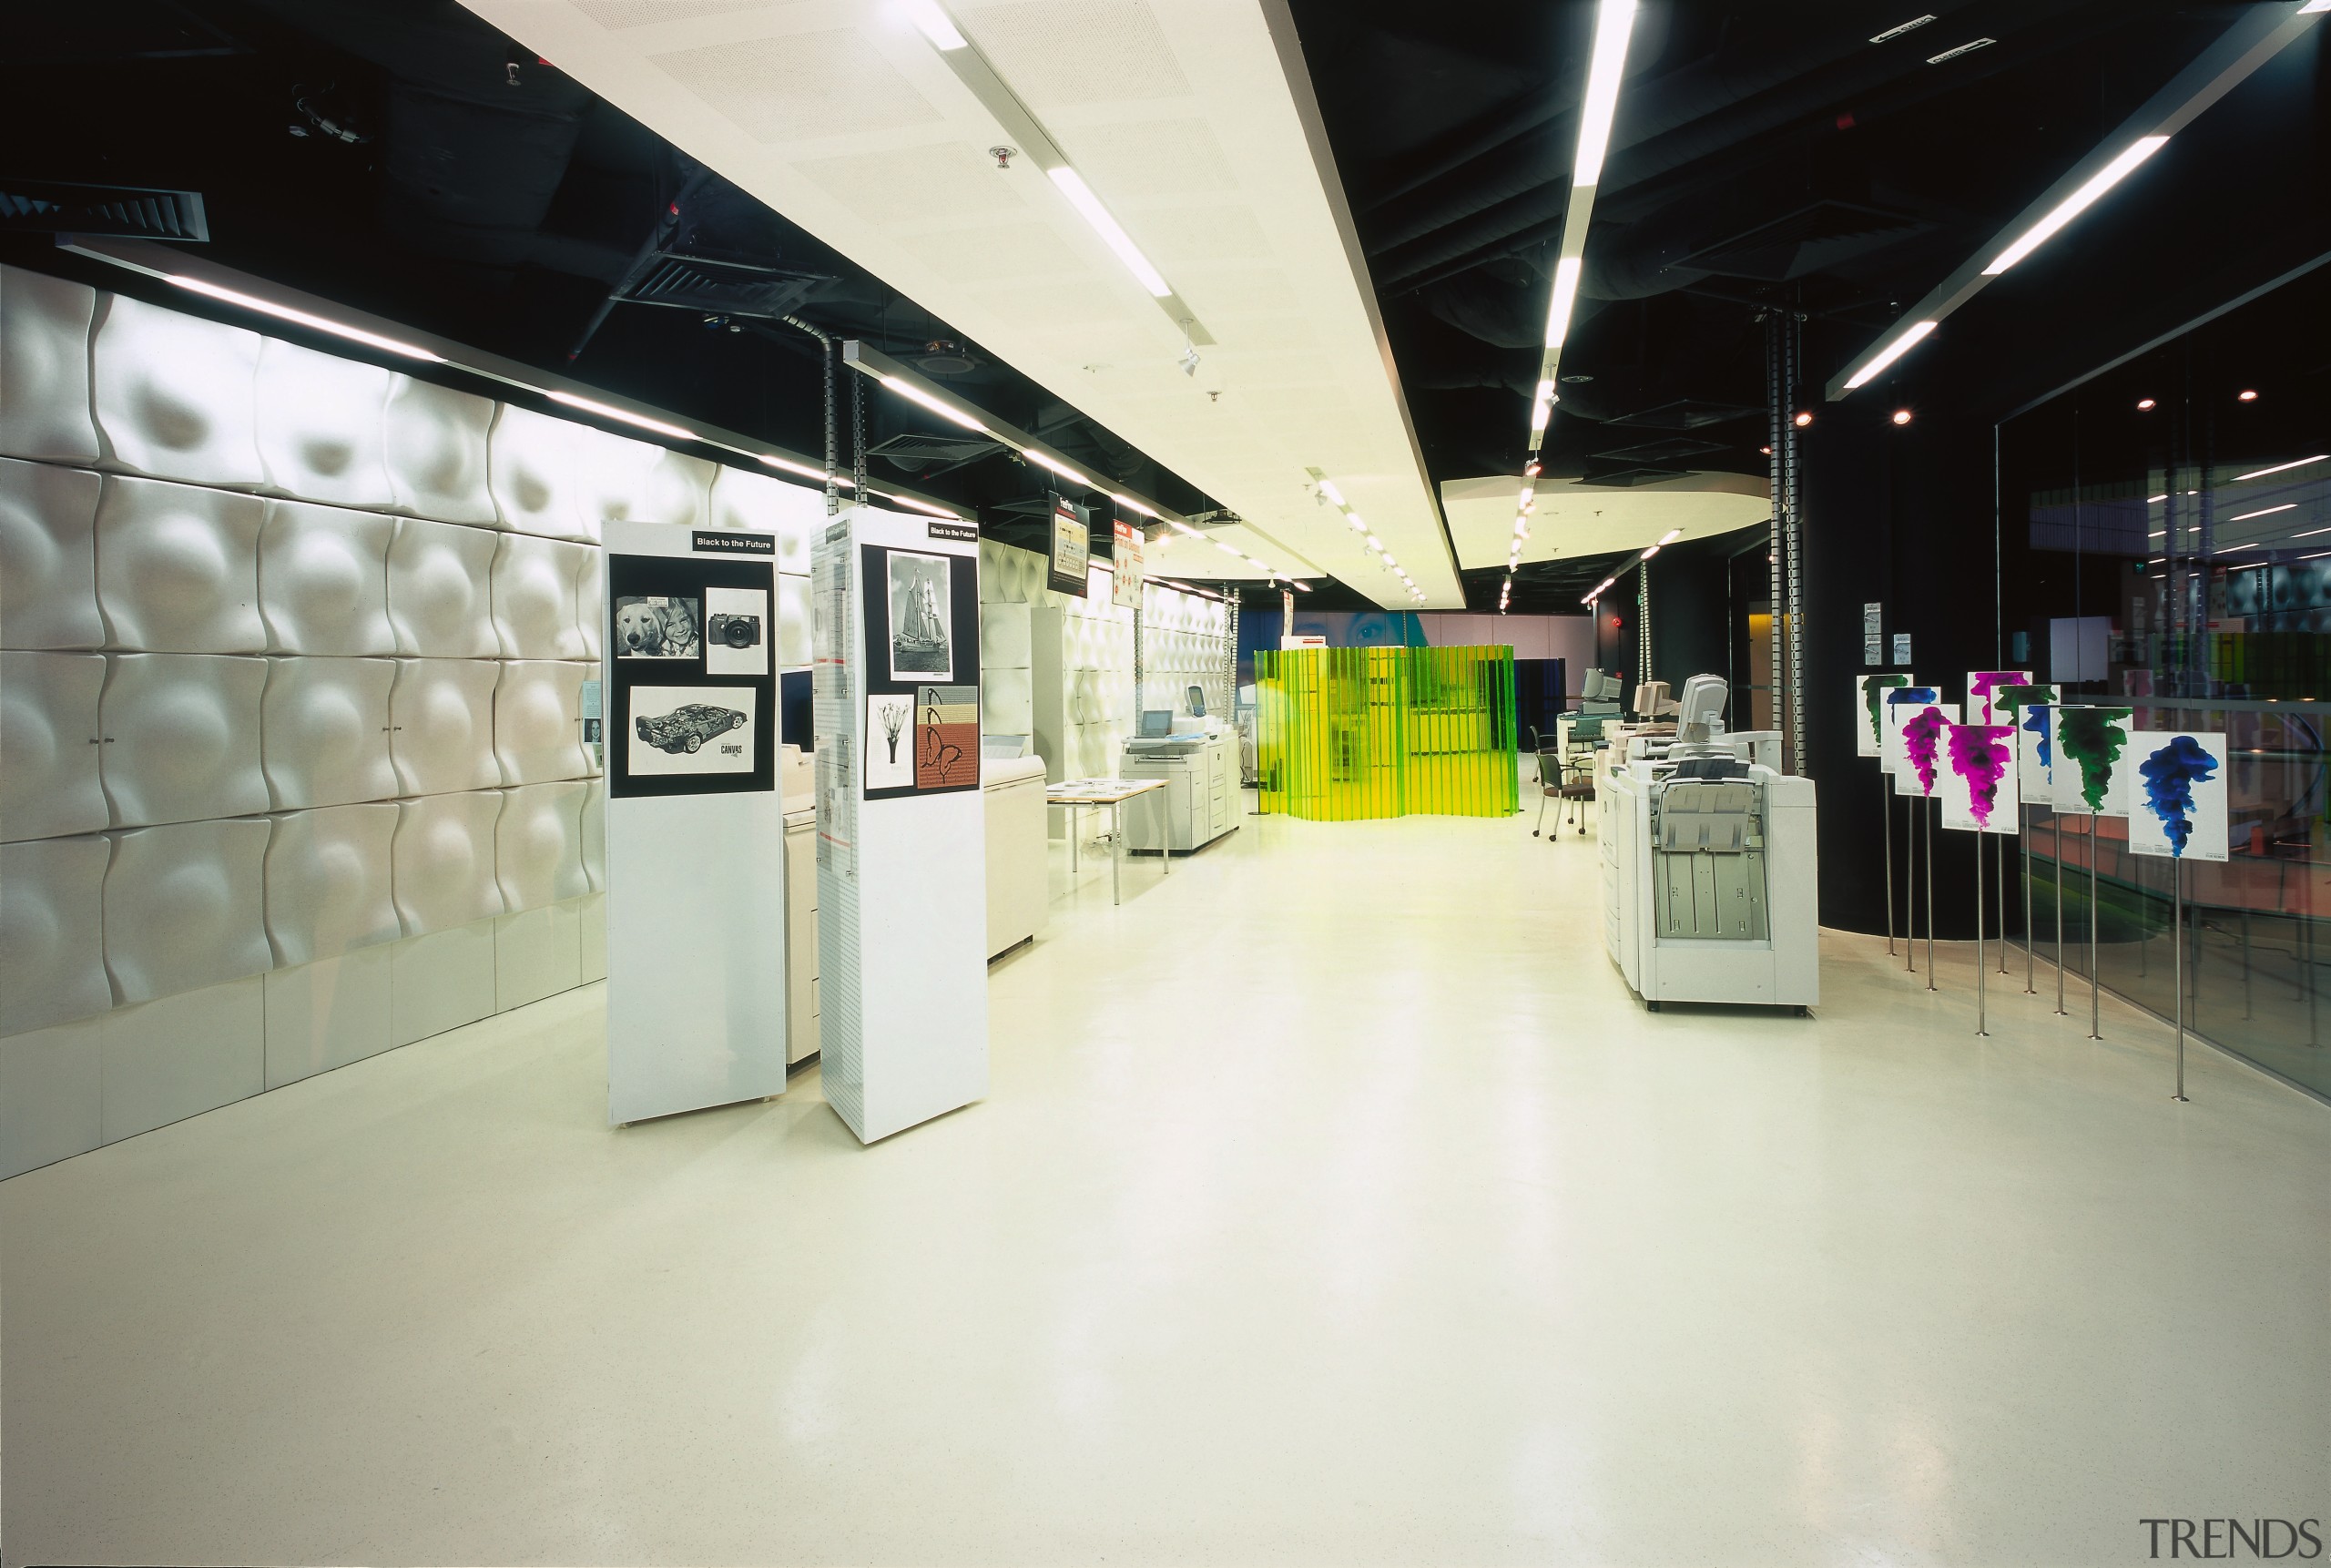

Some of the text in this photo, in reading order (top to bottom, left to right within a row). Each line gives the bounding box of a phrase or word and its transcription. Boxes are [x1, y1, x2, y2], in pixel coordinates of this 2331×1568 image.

[960, 530, 975, 538] Future
[697, 537, 720, 545] Black
[731, 539, 744, 547] the
[746, 540, 771, 549] Future
[720, 745, 742, 754] CANVAS
